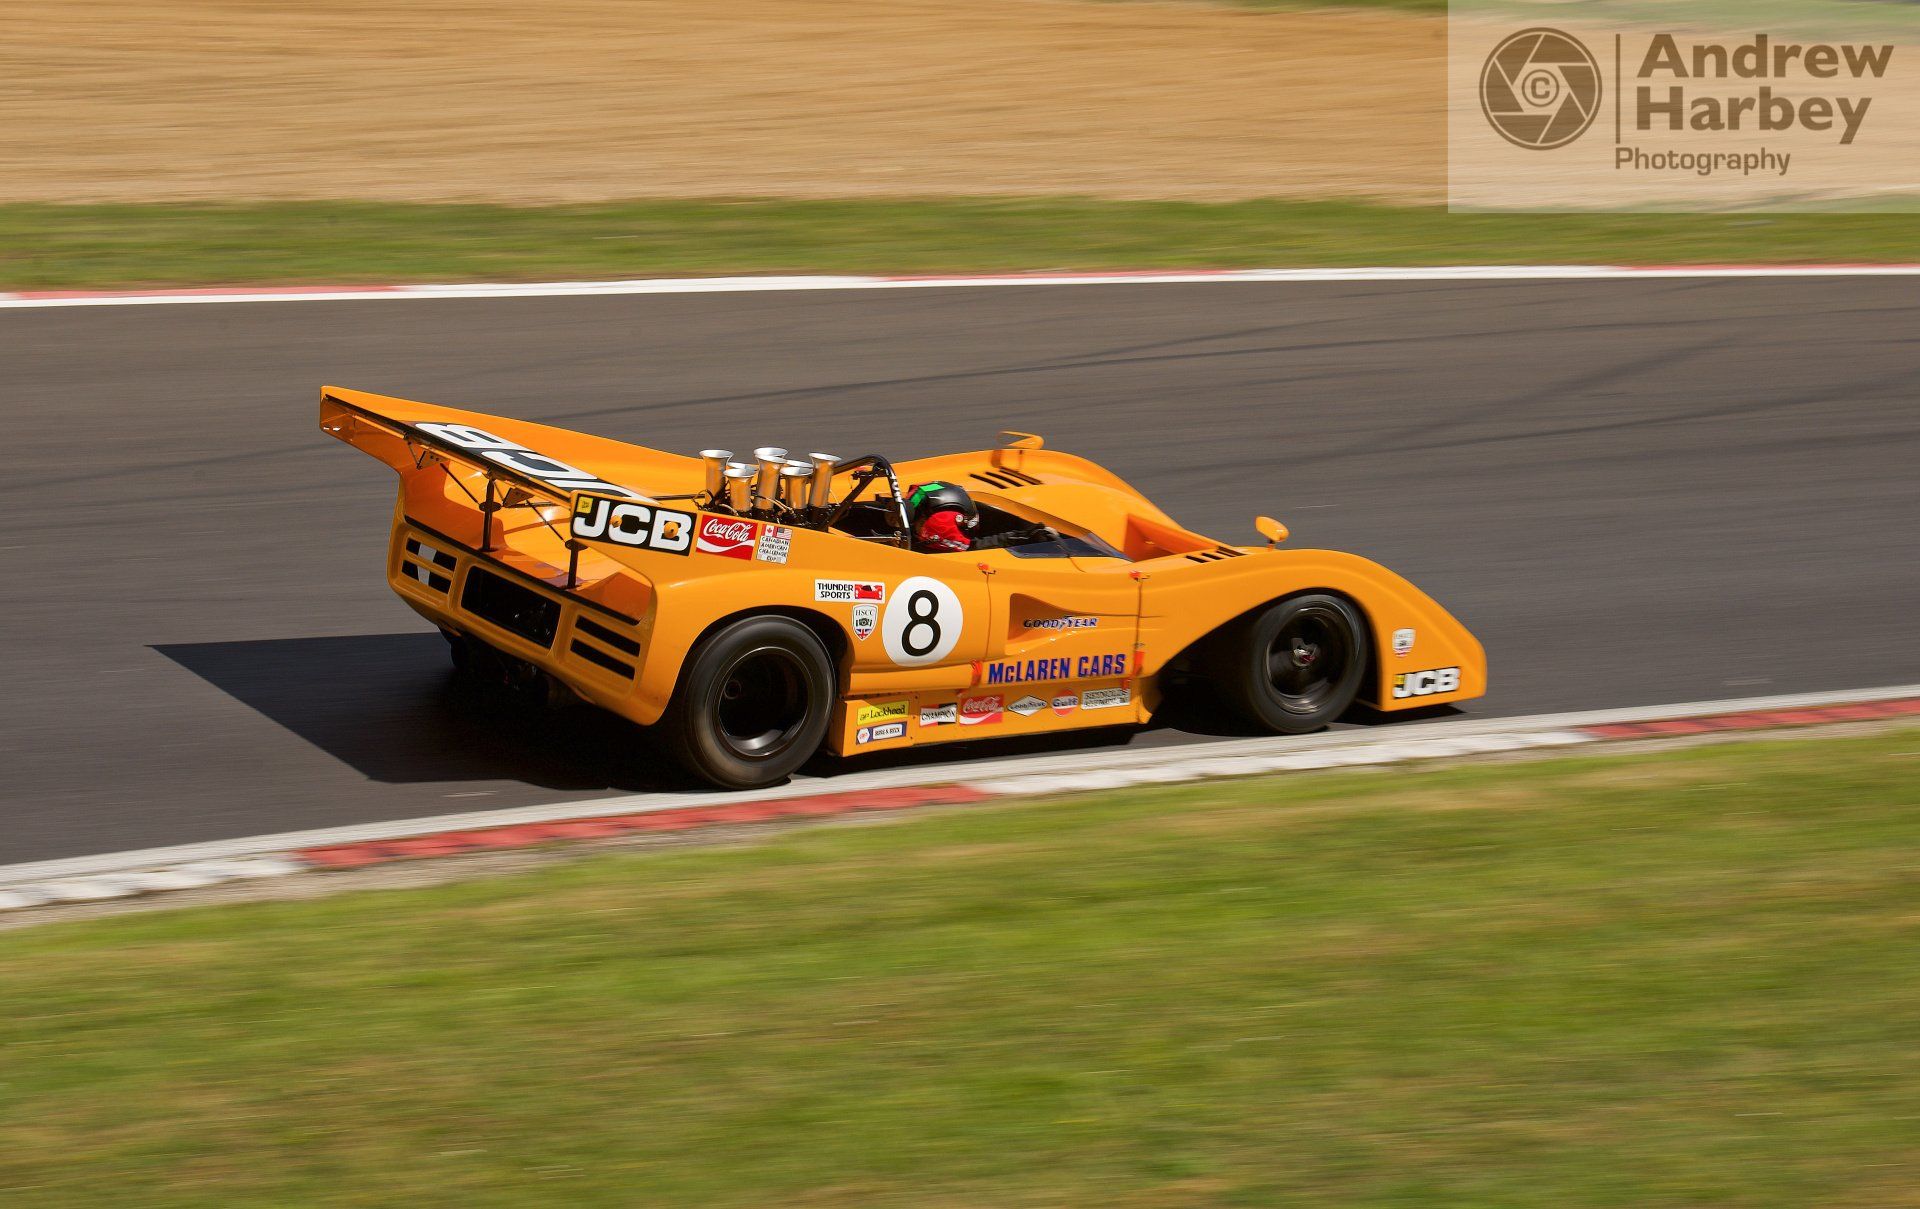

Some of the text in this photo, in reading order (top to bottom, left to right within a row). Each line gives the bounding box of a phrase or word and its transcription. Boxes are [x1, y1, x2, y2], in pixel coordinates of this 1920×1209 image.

[573, 500, 692, 551] JCB
[817, 582, 854, 592] THUNDER
[820, 591, 851, 599] SPORTS
[901, 589, 941, 656] 8
[1077, 653, 1126, 678] CARS
[1392, 667, 1461, 698] JCB
[870, 704, 906, 719] Lockheed
